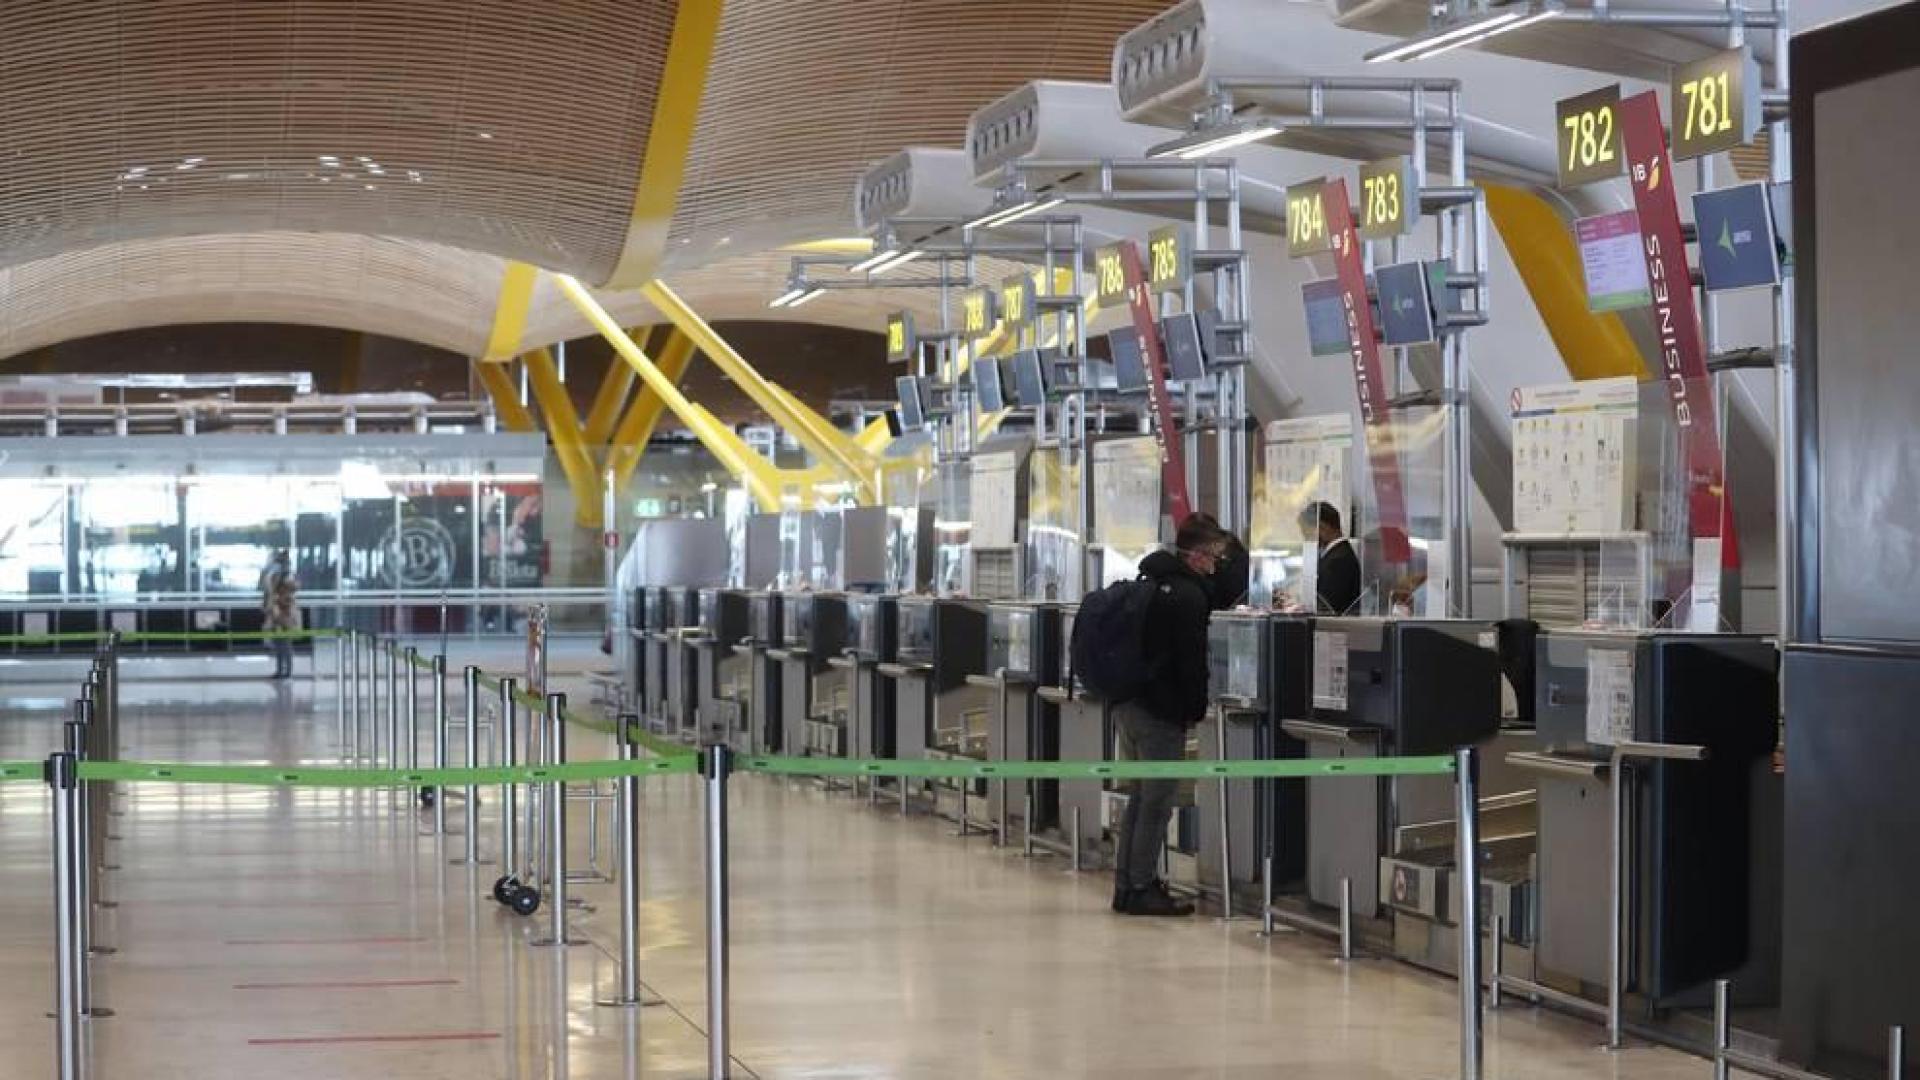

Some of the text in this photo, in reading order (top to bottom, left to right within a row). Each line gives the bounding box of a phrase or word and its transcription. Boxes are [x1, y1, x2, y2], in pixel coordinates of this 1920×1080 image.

[1681, 71, 1733, 141] 781
[1564, 105, 1615, 172] 782
[1290, 193, 1324, 246] 784
[1364, 173, 1400, 226] 783
[1098, 253, 1124, 296] 786
[1151, 237, 1177, 283] 785
[1646, 233, 1692, 426] BUSINESS
